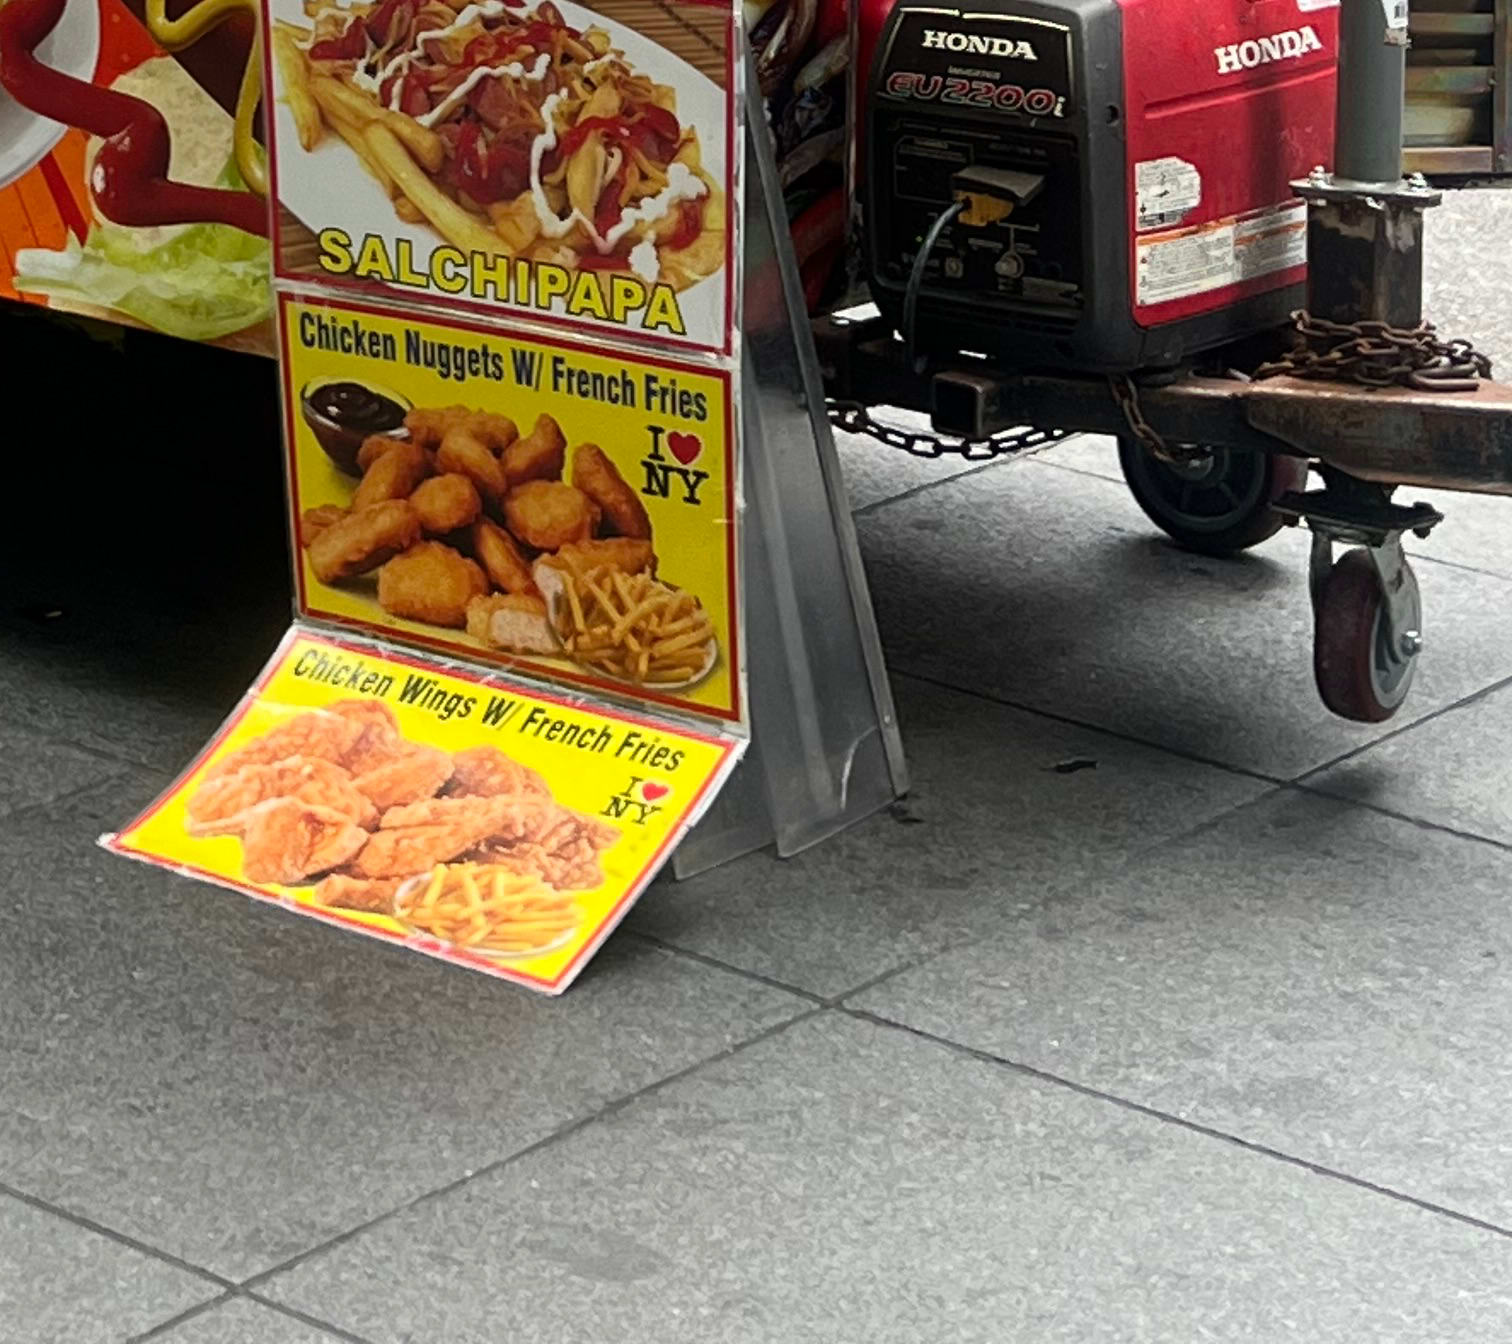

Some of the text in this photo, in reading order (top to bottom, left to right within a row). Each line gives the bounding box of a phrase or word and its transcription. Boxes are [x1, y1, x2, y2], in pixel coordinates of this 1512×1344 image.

[921, 29, 1037, 60] HONDA
[1214, 26, 1323, 75] HONDA
[887, 71, 1064, 117] EU2200i
[318, 228, 687, 335] SALCHIPAPA
[300, 311, 708, 422] Chicken Nuggets W/ French Fries
[645, 425, 664, 461] I
[640, 461, 710, 506] NY
[293, 648, 687, 774] Chicken Wings W/ French Fries
[624, 776, 643, 798] I
[599, 795, 665, 826] NY
